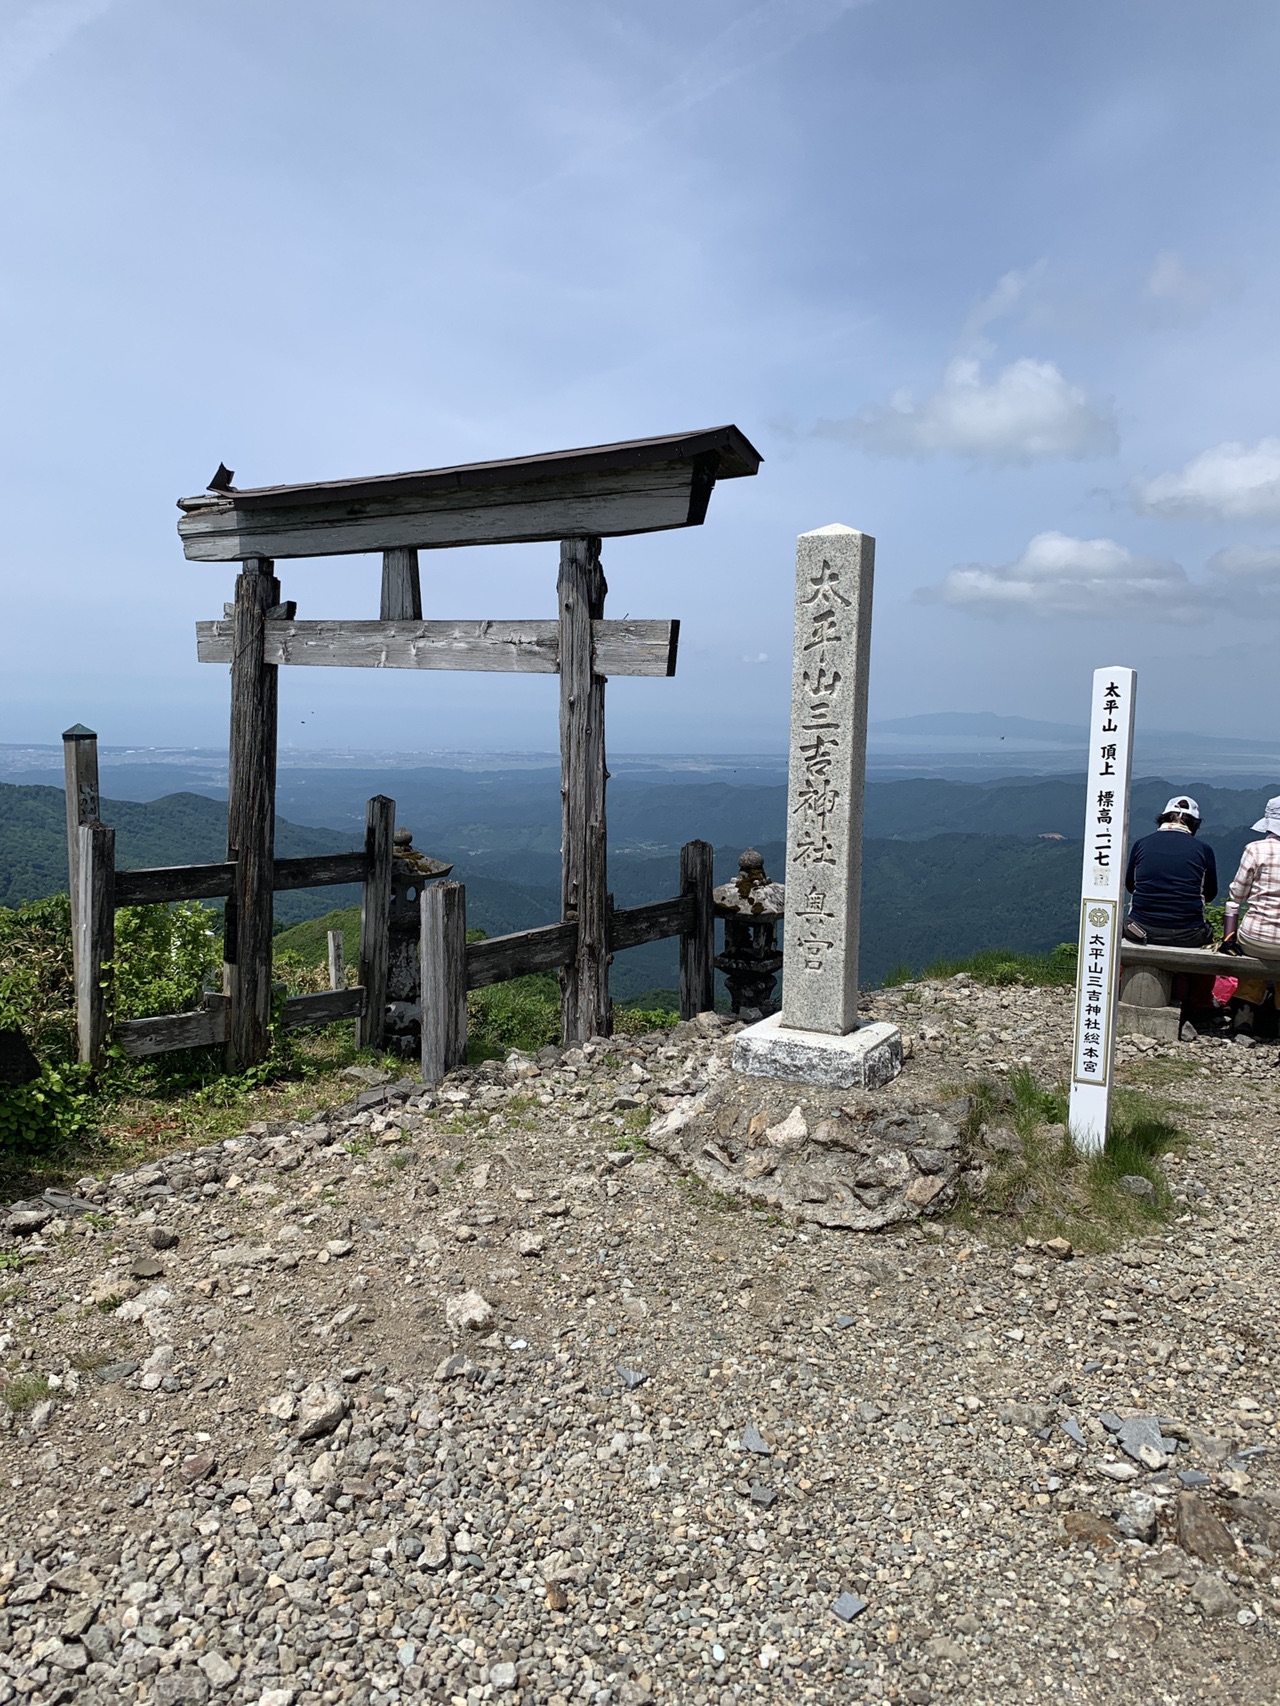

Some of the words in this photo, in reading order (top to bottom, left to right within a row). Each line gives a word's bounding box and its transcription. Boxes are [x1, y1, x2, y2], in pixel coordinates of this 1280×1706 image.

[793, 559, 851, 869] 太平山三吉神社
[1102, 681, 1121, 732] 太平山
[1099, 743, 1117, 776] 頂上
[1083, 934, 1105, 1073] 太平山三吉神社総本宮
